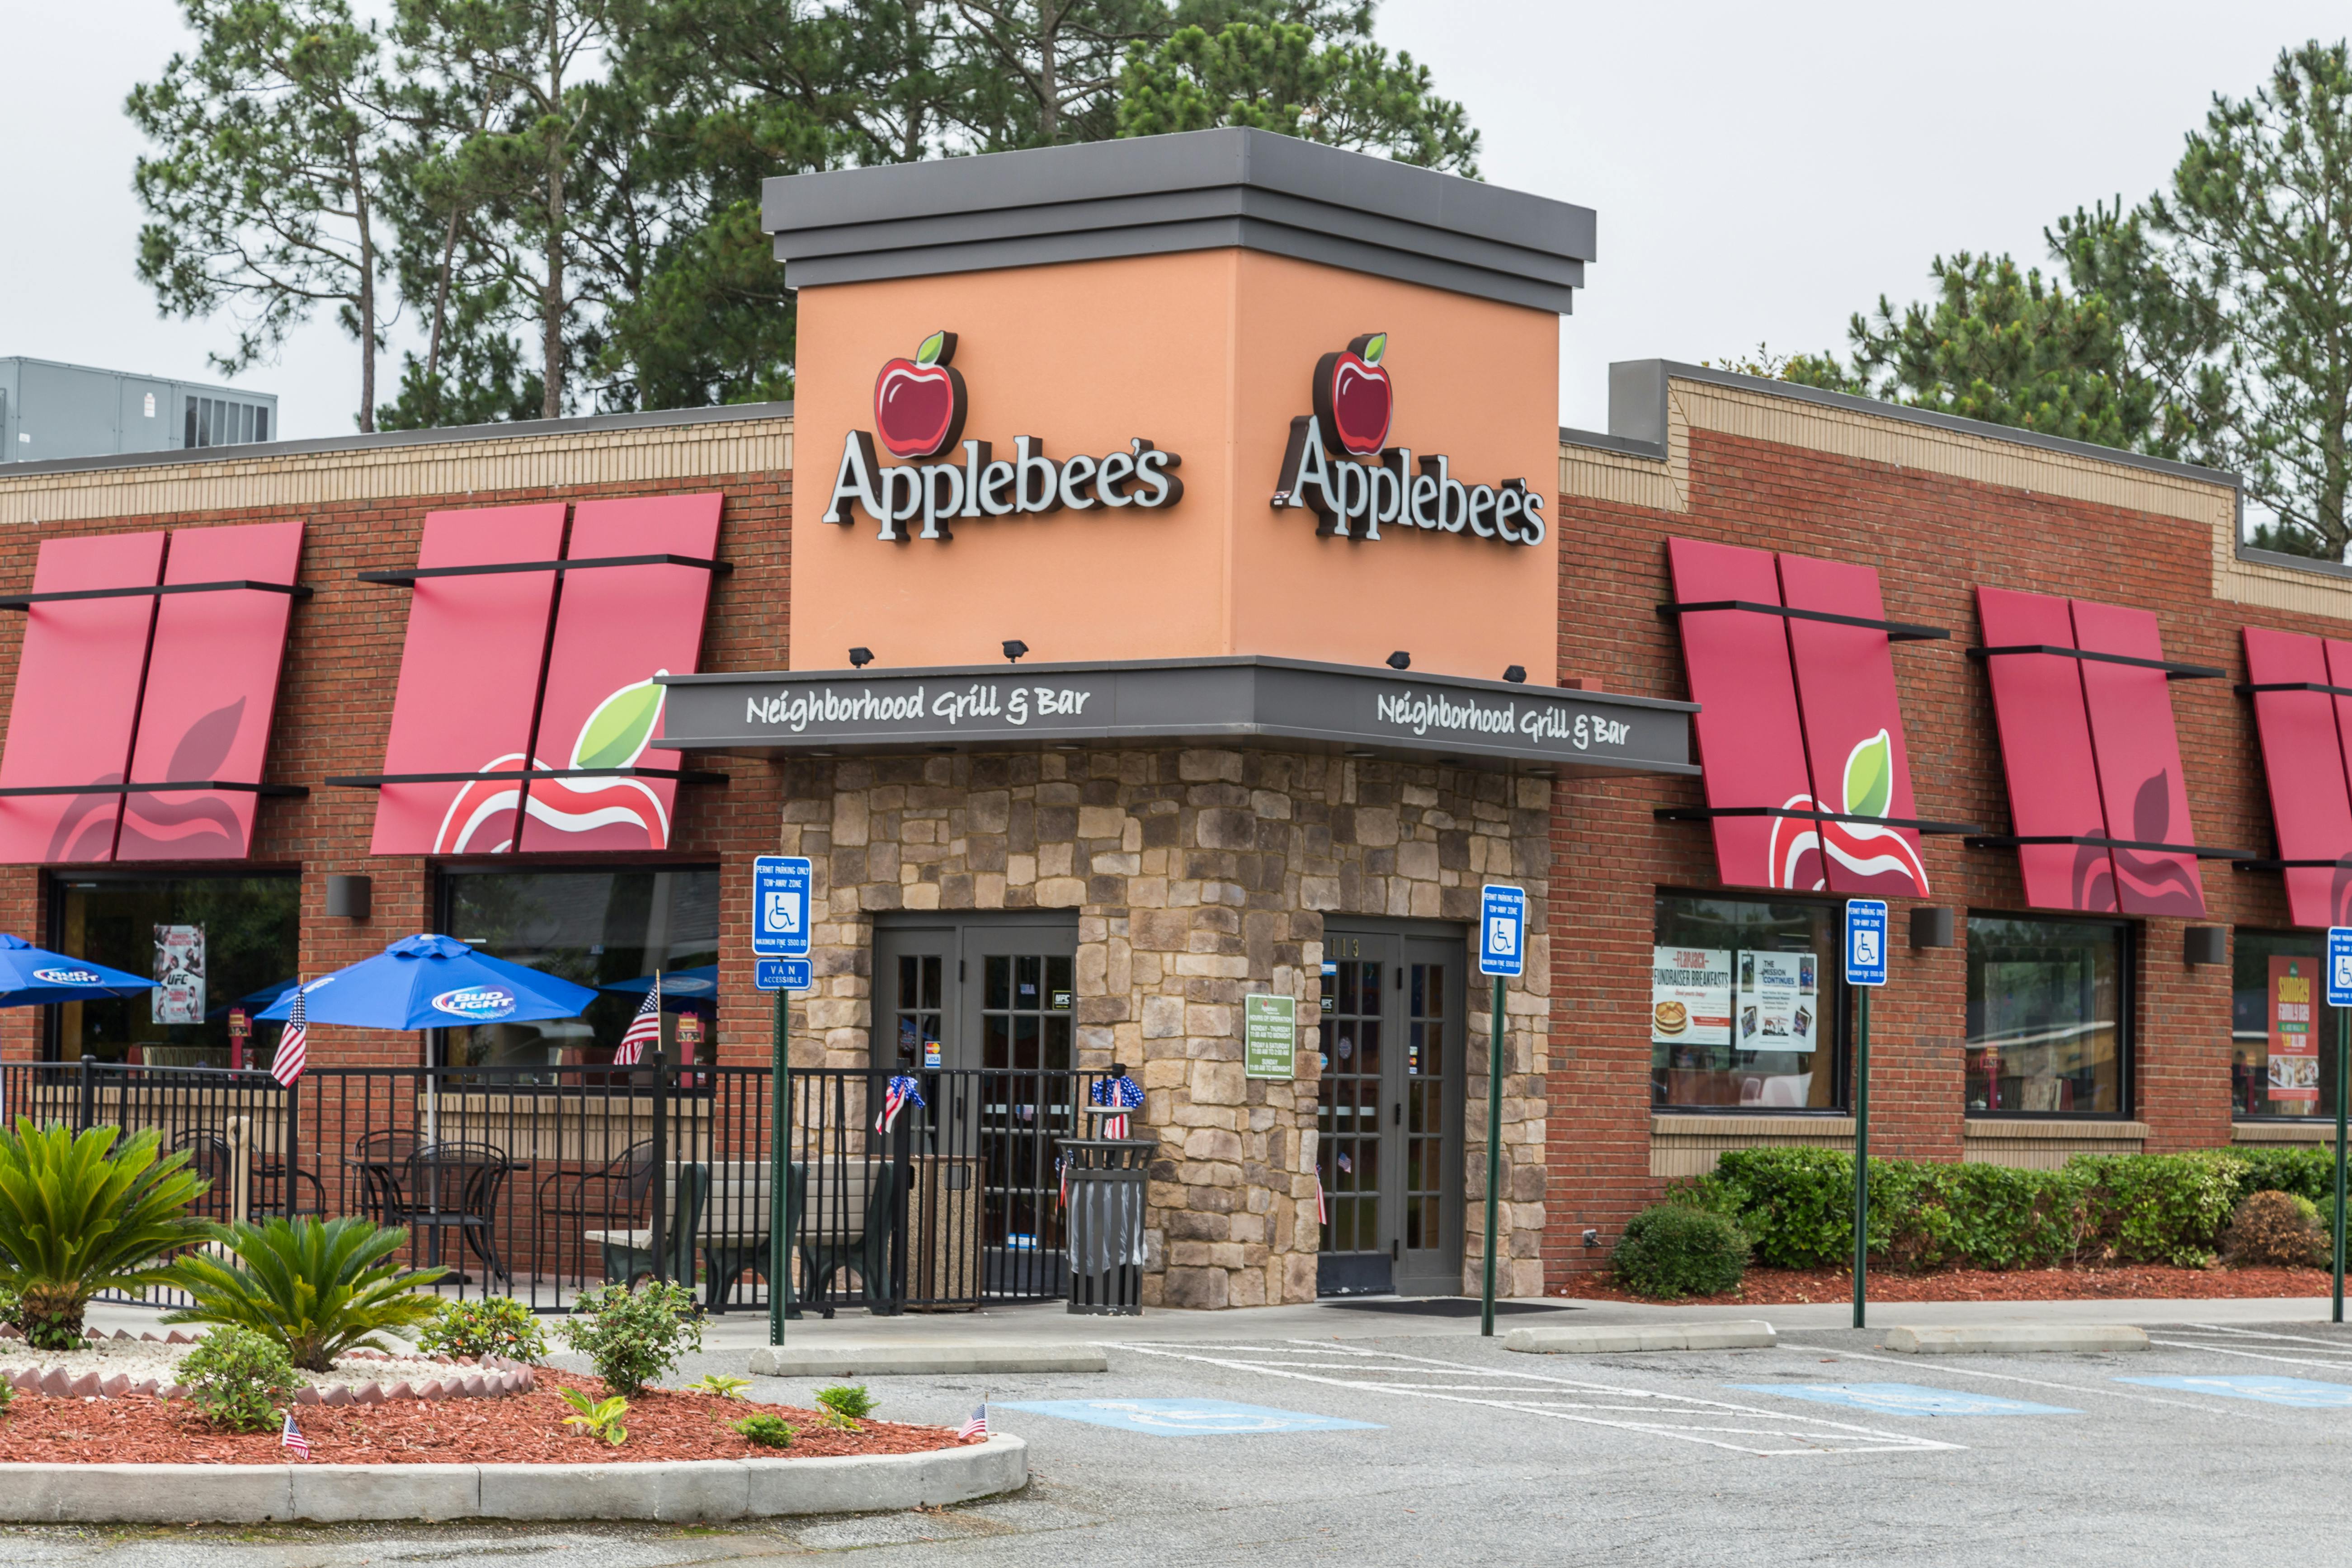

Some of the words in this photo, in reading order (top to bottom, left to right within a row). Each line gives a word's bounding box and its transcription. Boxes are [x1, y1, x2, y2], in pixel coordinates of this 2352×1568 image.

[822, 429, 1171, 540] Applebee's
[1288, 414, 1546, 546] Applebee's
[747, 686, 924, 732] Neighborhood
[932, 684, 1001, 725] Grill
[1005, 687, 1028, 725] &
[1034, 687, 1090, 716] Bar
[1377, 691, 1515, 735] Neighborhood
[1520, 706, 1570, 743] Grill
[1573, 714, 1588, 750] &
[1591, 715, 1631, 745] Bar
[757, 865, 774, 874] PERMIT
[775, 866, 796, 875] PARKING
[797, 866, 810, 876] ONLY
[763, 878, 787, 887] TOW-AWAY
[788, 879, 802, 888] ZONE
[1498, 894, 1513, 903] PARKING
[1507, 906, 1518, 915] ZONE
[770, 965, 795, 975] VAN
[1763, 968, 1786, 976] MISSION
[167, 974, 188, 985] UFC
[1654, 968, 1690, 986] FUNDRAISER
[1692, 970, 1729, 989] BREAKFASTS
[1763, 976, 1795, 985] CONTINUES
[454, 991, 504, 1002] BUD
[448, 998, 514, 1010] LIGHT
[1270, 1015, 1292, 1023] OPERATION
